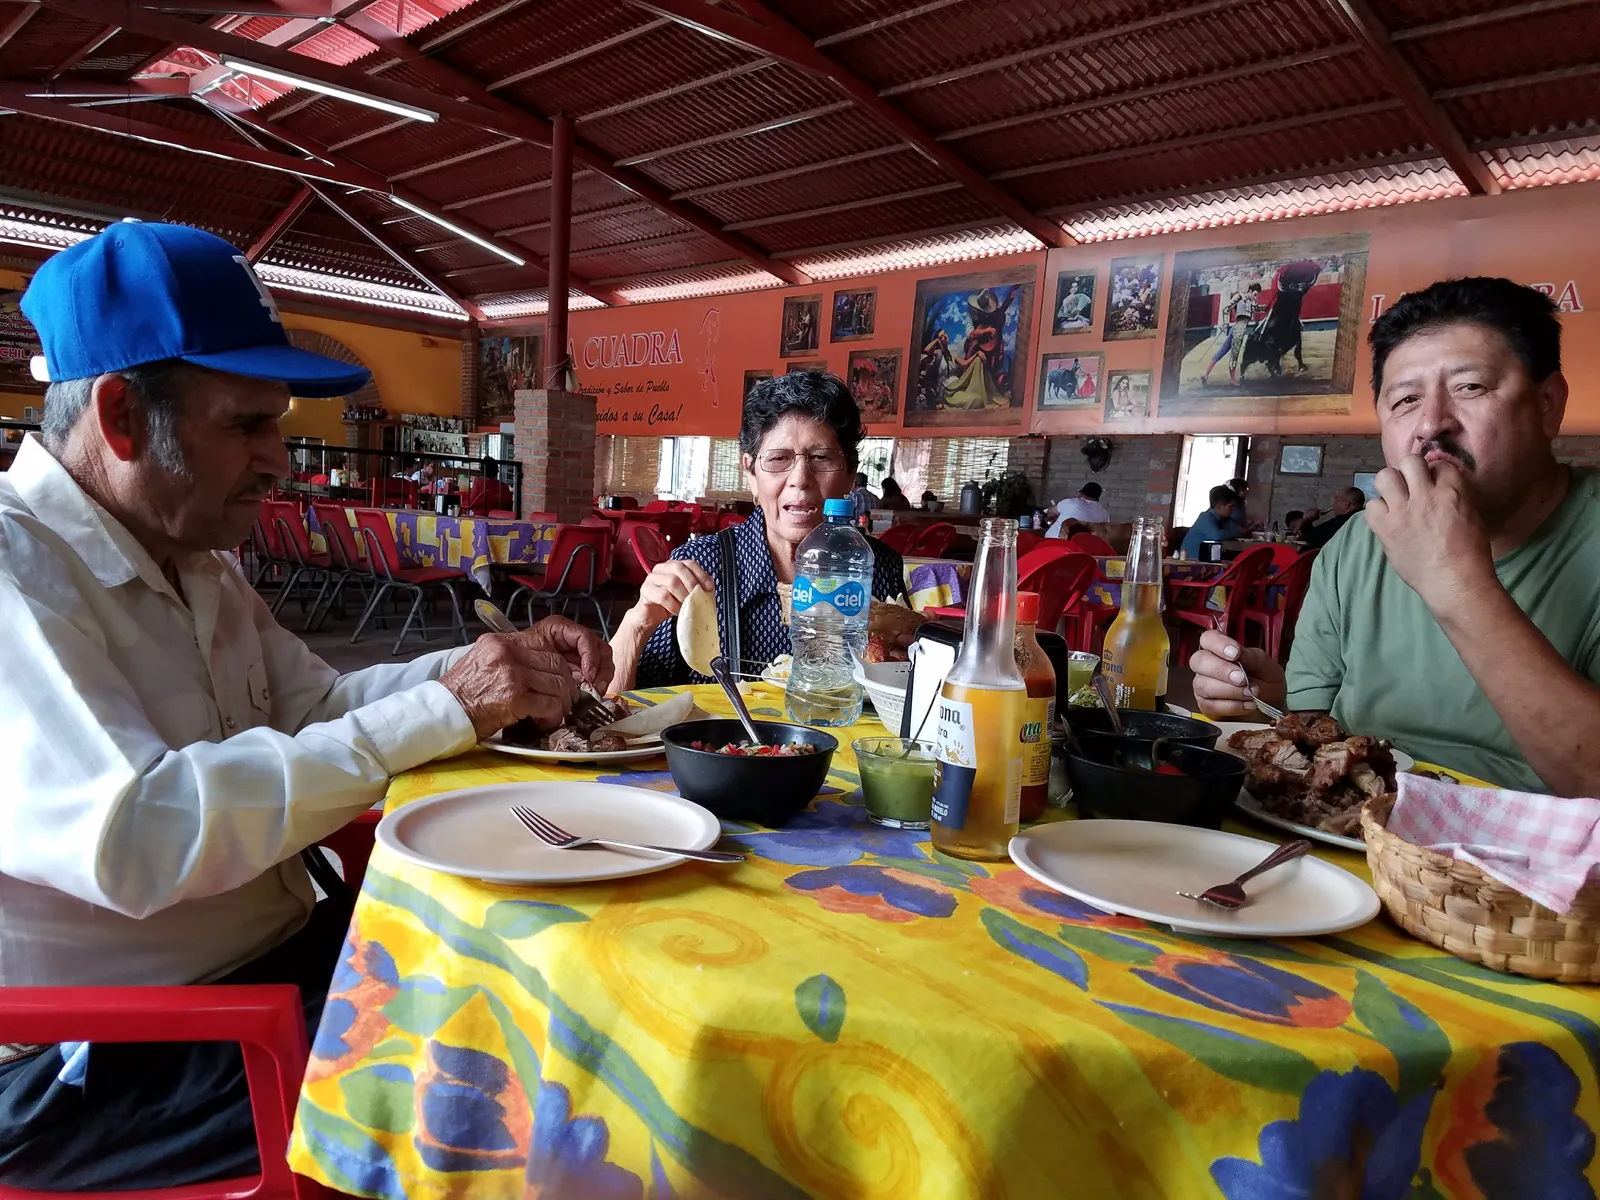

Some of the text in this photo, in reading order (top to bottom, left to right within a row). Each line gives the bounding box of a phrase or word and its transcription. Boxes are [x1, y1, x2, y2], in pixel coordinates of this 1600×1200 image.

[583, 329, 683, 369] CUADRA
[614, 382, 634, 394] Sabor
[635, 383, 643, 393] de
[646, 380, 670, 393] Pueblo
[632, 411, 643, 421] su
[648, 403, 684, 425] Casa!
[792, 583, 813, 603] ciel
[834, 588, 863, 606] ciel
